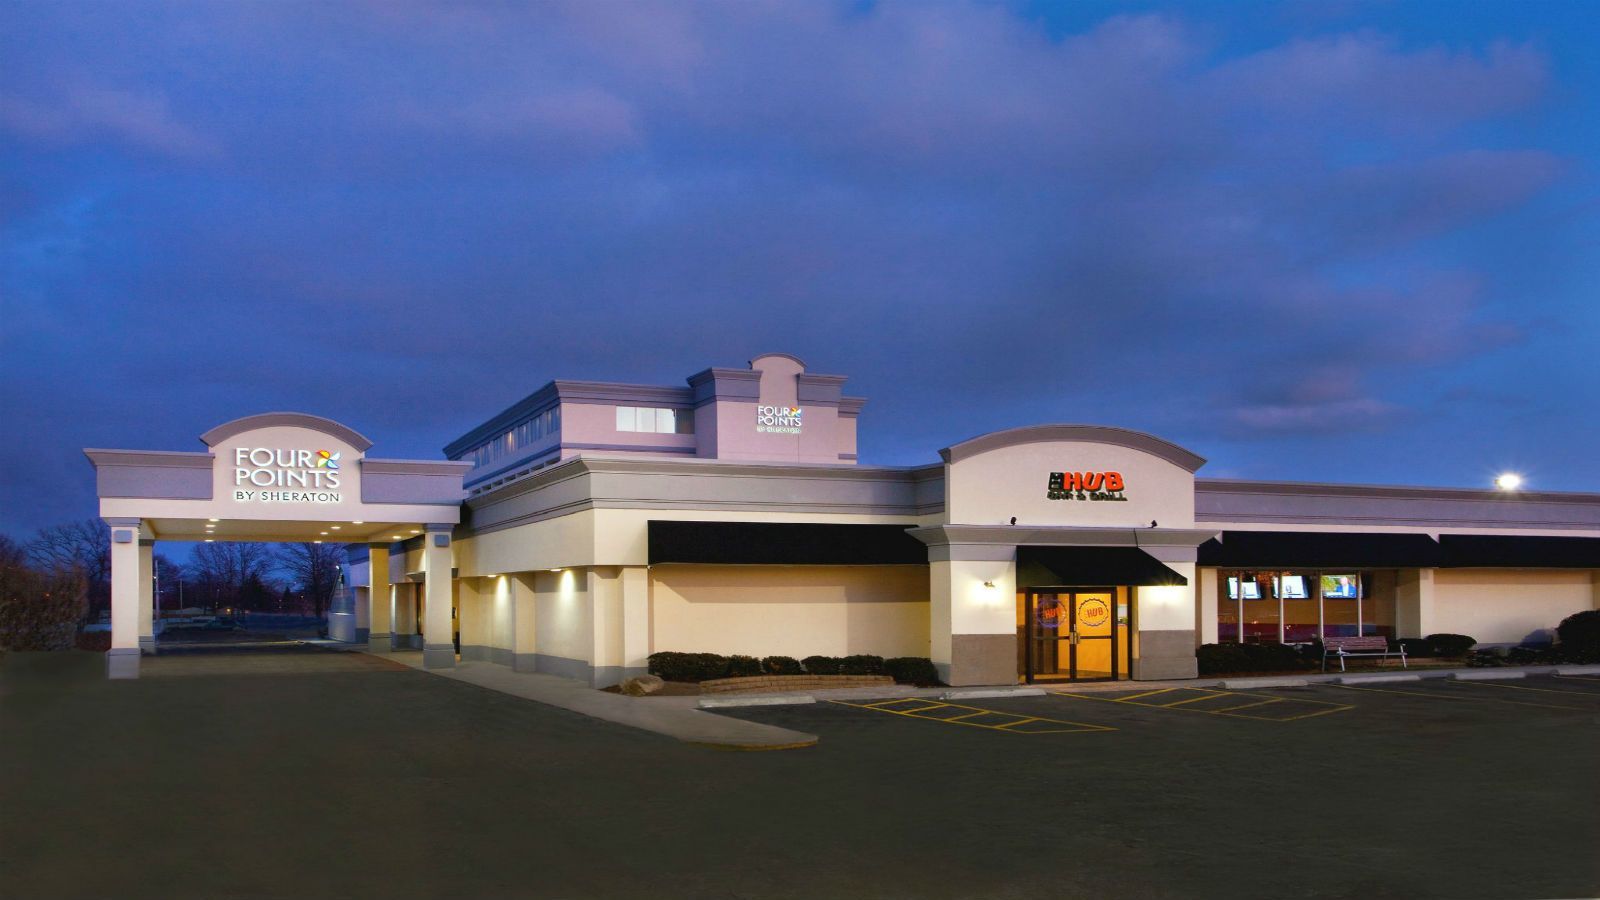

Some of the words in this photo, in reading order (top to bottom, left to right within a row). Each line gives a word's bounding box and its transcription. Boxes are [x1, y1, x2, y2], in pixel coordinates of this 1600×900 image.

[757, 406, 791, 416] FOUR
[757, 416, 802, 426] POINTS
[235, 448, 315, 468] FOUR
[235, 469, 340, 488] POINTS
[1064, 472, 1124, 491] HUB
[236, 491, 255, 500] BY
[261, 491, 340, 502] SHERATON
[1086, 606, 1104, 618] HUB
